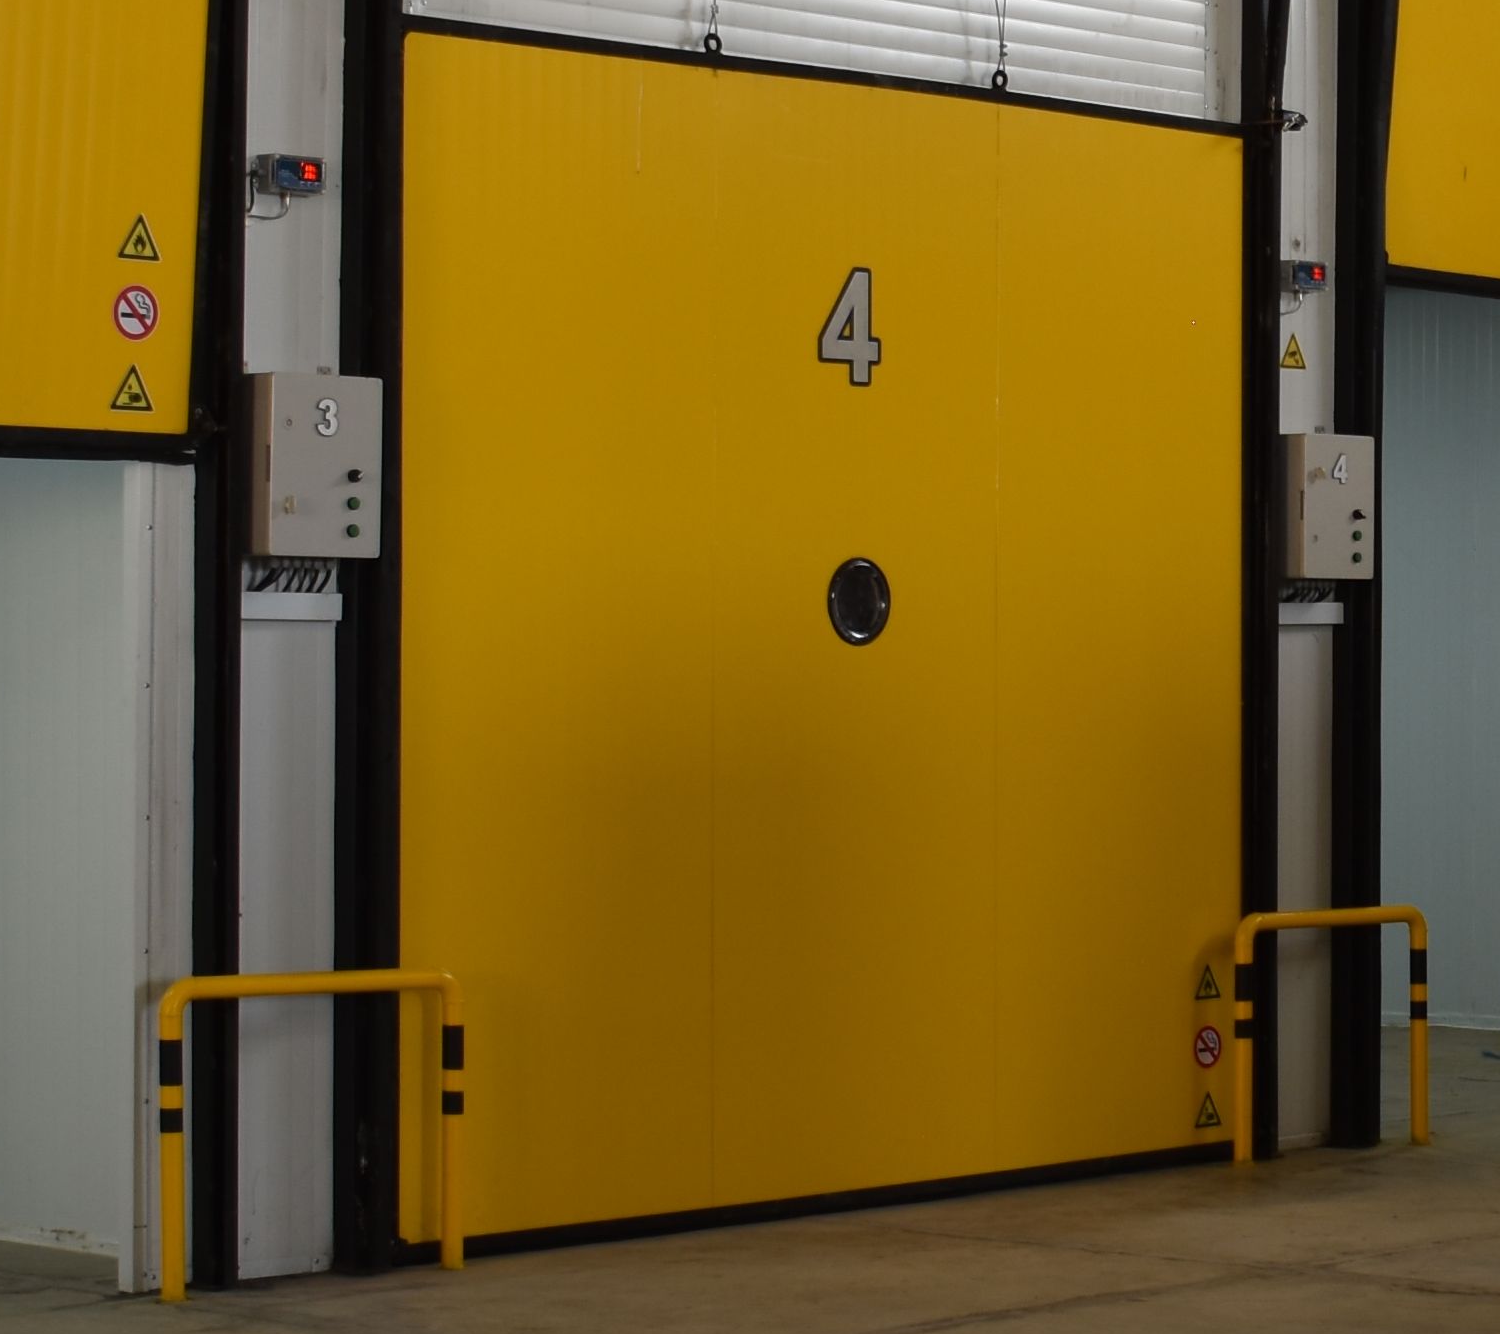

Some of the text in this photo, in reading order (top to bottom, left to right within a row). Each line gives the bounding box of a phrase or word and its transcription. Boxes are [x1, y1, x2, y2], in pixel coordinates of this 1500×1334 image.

[818, 267, 881, 386] 4
[316, 399, 340, 437] 3
[1332, 454, 1349, 485] 4
